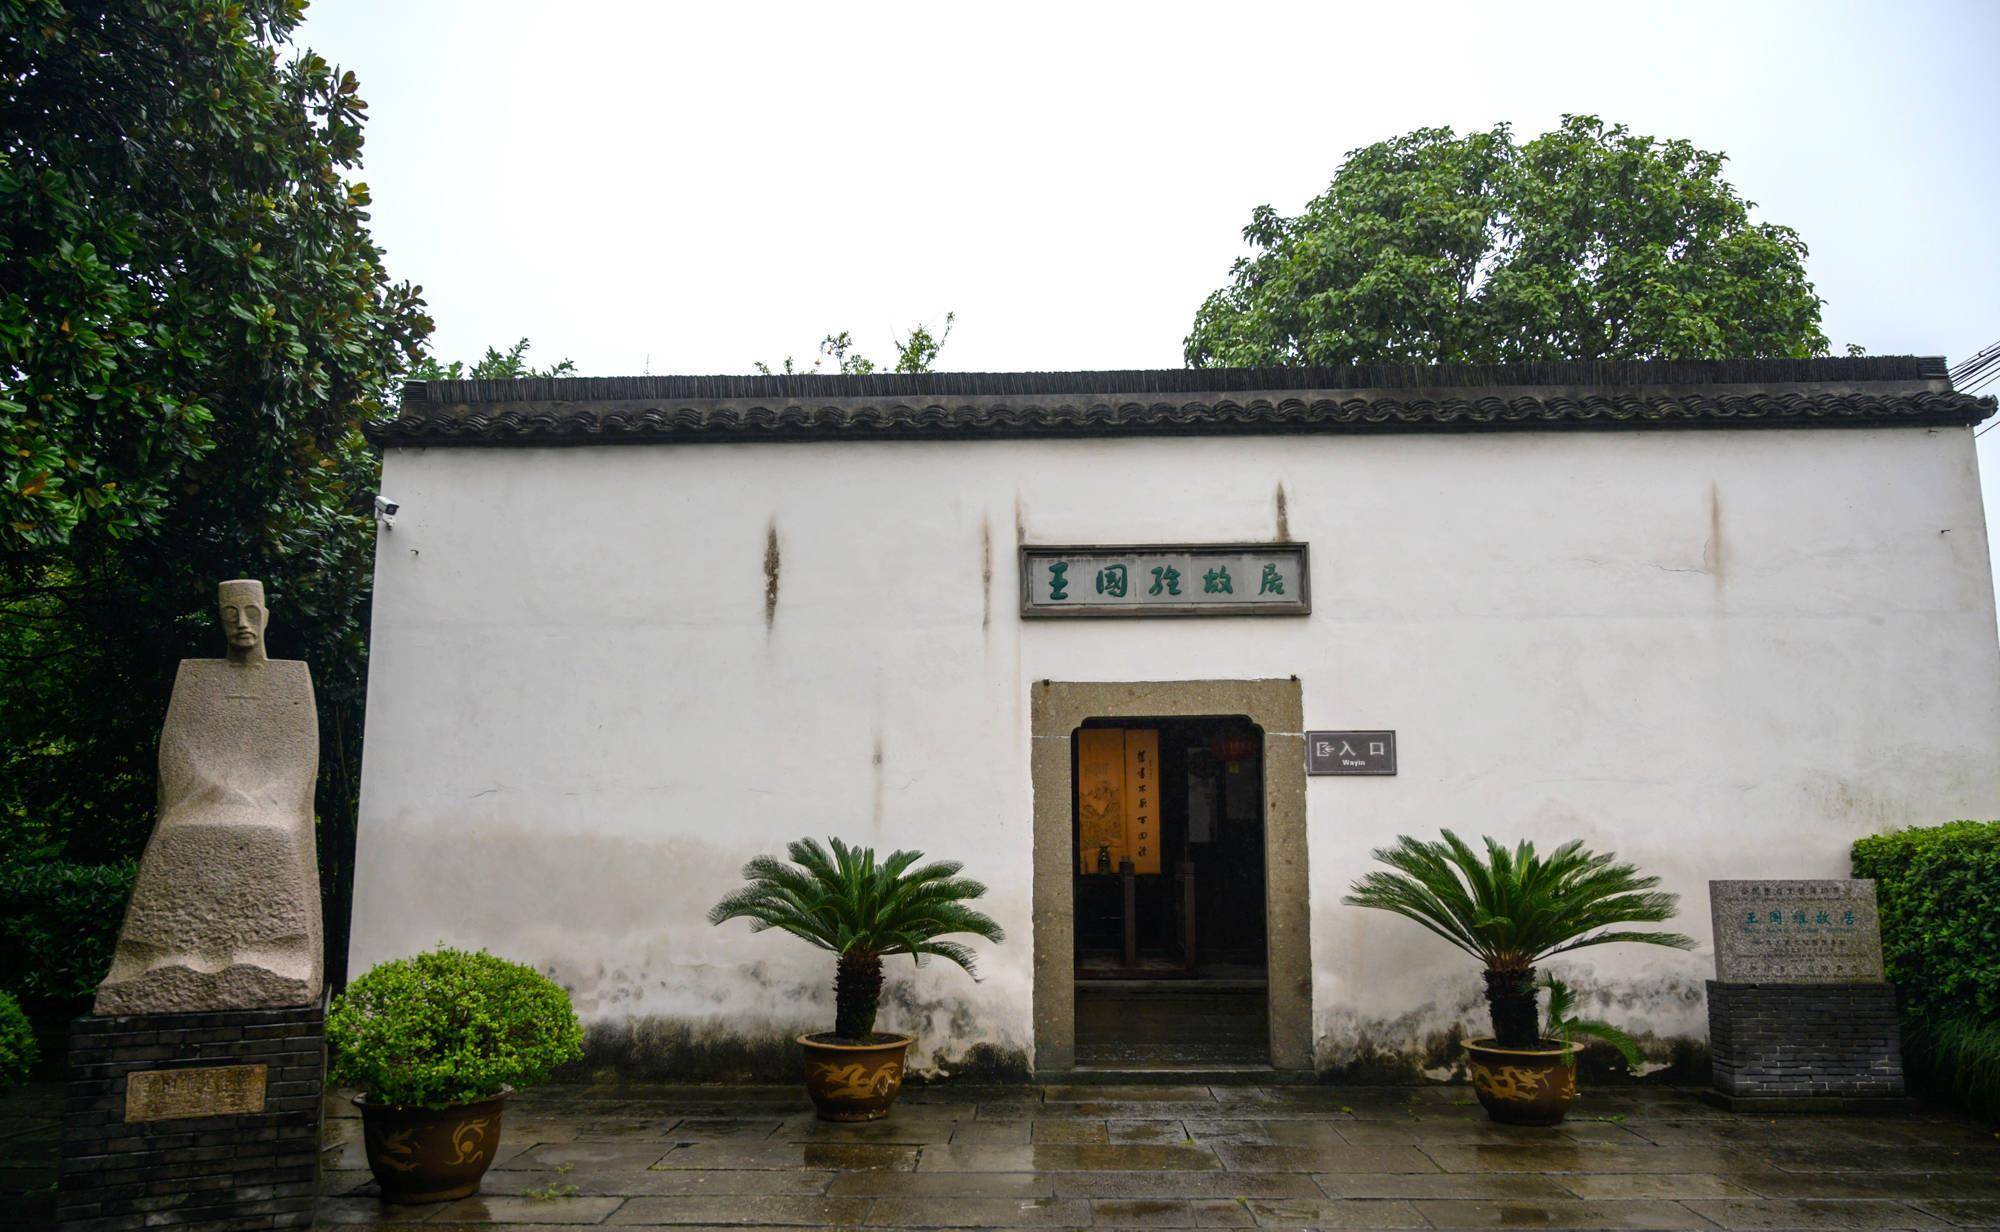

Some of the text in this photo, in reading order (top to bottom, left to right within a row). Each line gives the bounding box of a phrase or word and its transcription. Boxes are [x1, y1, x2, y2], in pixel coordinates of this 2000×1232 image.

[1049, 561, 1285, 600] 王國維故居
[1339, 741, 1384, 756] 入口
[1342, 759, 1366, 767] Wayin
